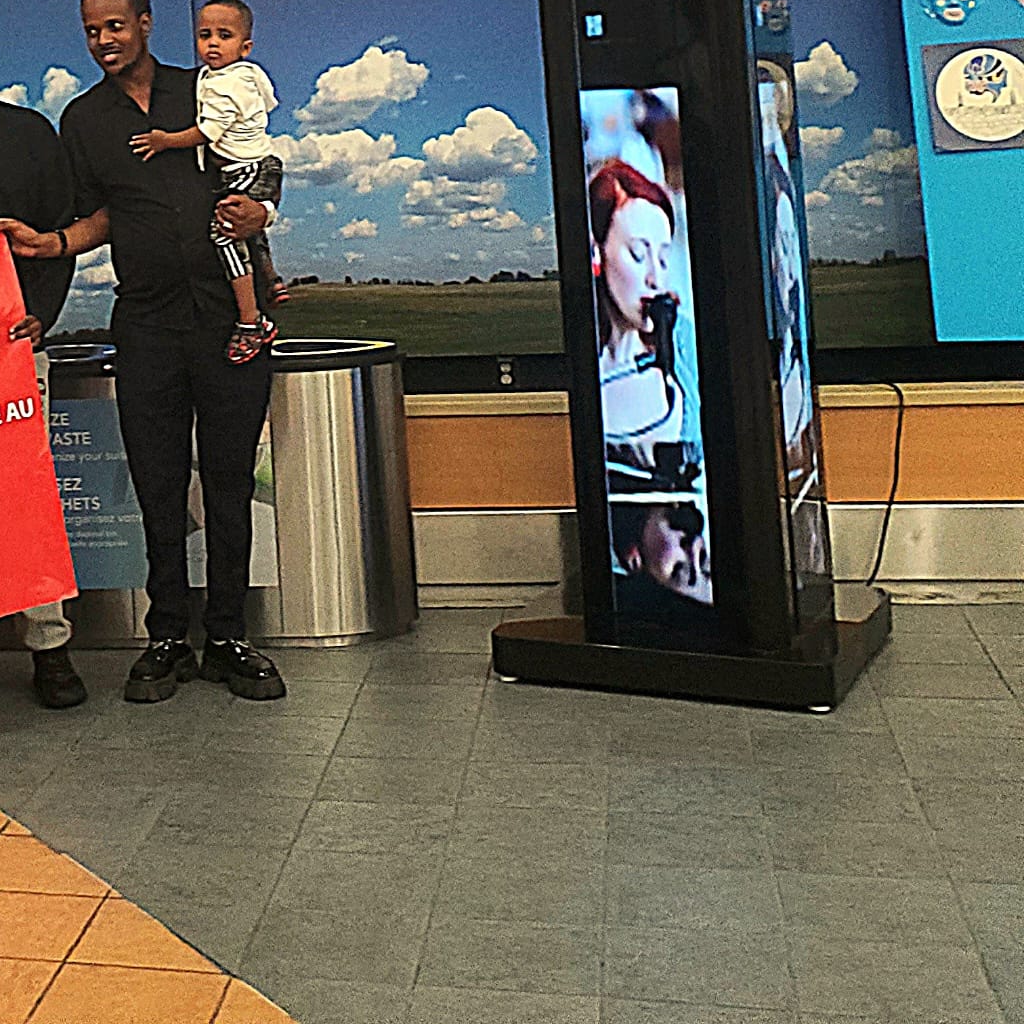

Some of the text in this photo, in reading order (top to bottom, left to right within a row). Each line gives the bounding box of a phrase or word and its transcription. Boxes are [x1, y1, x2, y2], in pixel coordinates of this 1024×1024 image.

[5, 397, 34, 423] AU
[49, 431, 92, 445] ASTE
[56, 477, 83, 491] SEZ
[61, 496, 101, 511] HETS
